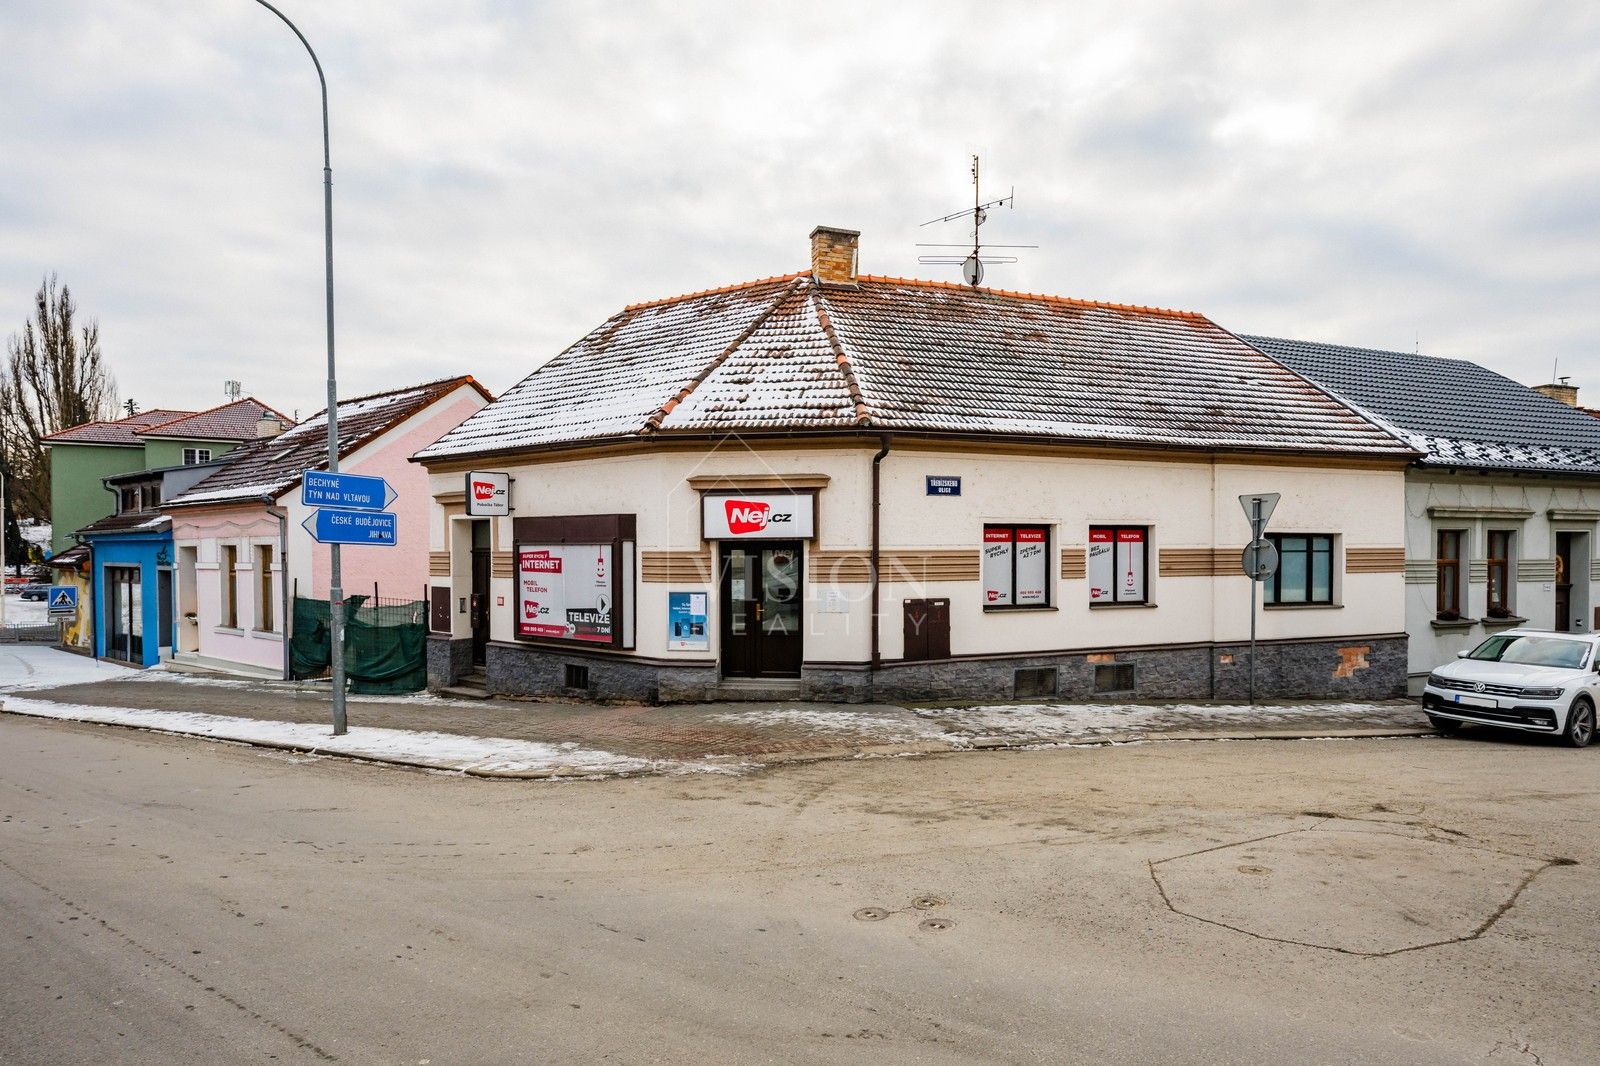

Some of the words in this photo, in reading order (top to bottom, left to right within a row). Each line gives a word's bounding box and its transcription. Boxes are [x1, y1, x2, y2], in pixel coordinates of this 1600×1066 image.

[308, 477, 340, 488] BECHYNĚ
[308, 489, 322, 499] TÝN
[325, 491, 340, 501] NAD
[343, 493, 371, 503] VLTAVOU
[331, 514, 352, 525] ČESKÉ
[355, 516, 392, 527] BUDĚJOVICE
[730, 507, 793, 528] Nej.cz
[522, 559, 560, 570] INTERNET
[568, 611, 610, 624] TELEVIZE
